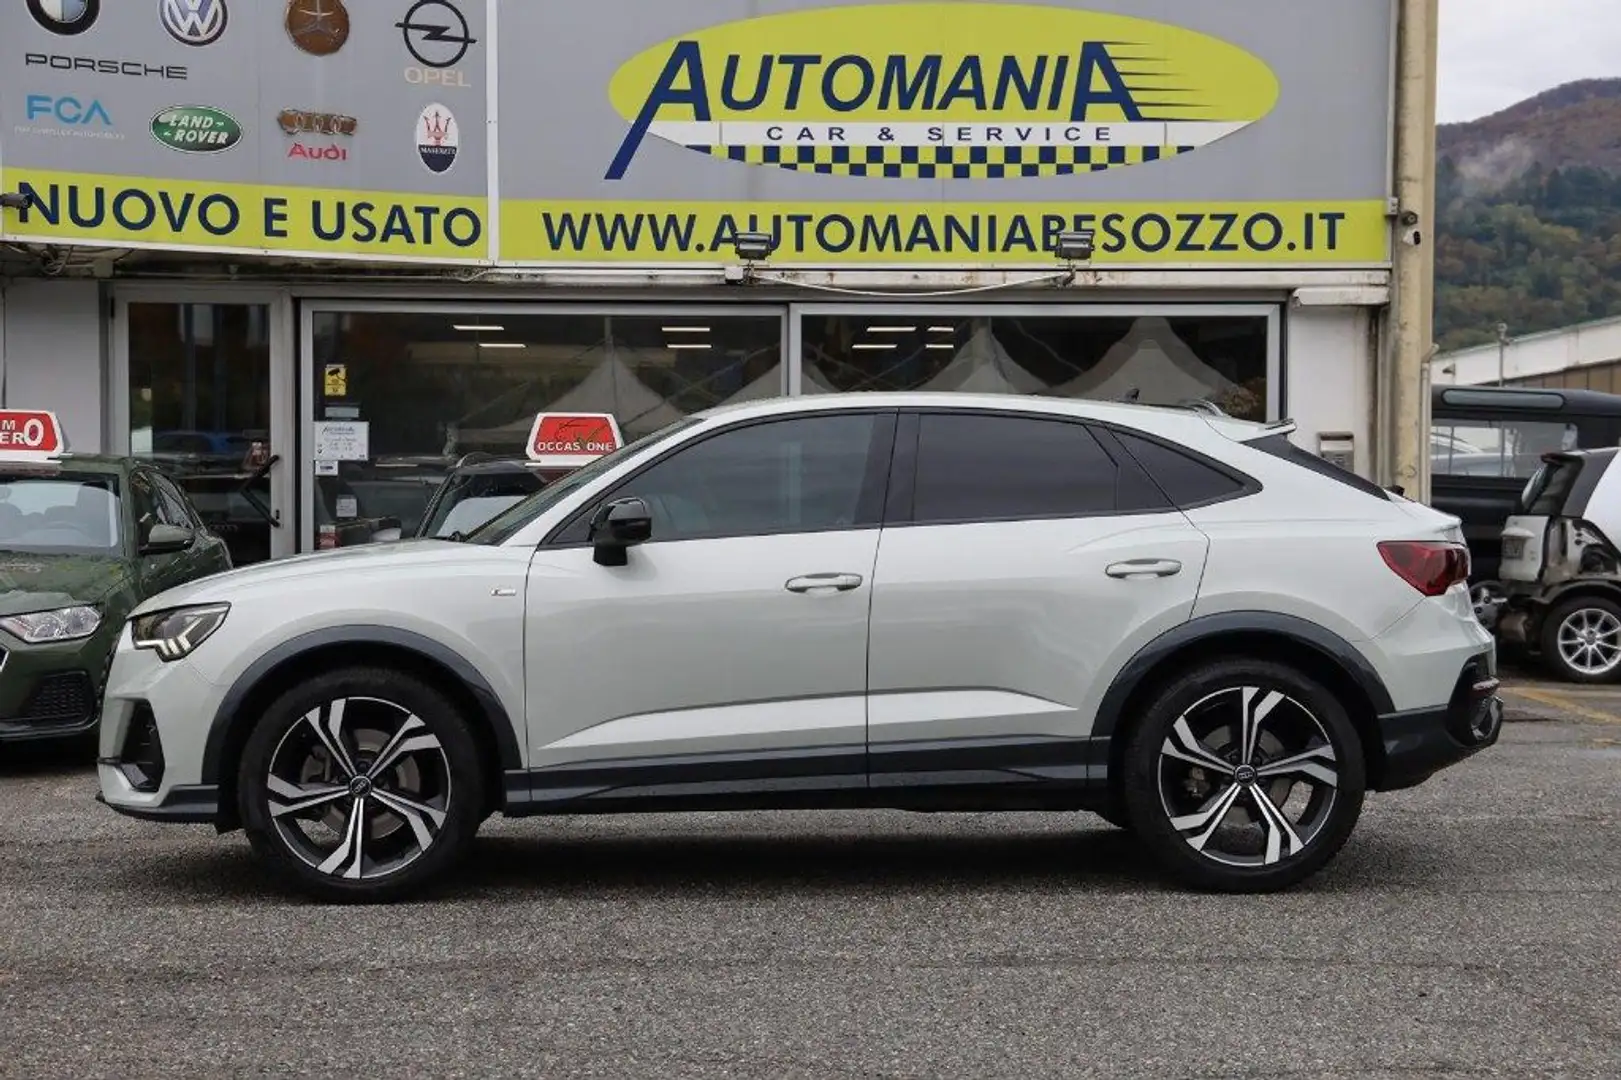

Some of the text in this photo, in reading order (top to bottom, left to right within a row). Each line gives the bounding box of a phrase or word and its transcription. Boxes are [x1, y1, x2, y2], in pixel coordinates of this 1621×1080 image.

[25, 53, 188, 80] PORSCHE
[404, 67, 472, 88] OPEL
[26, 95, 113, 125] FCA
[603, 40, 1143, 180] AUTOMANIA
[169, 115, 214, 129] LAND
[174, 129, 229, 145] ROVER
[766, 126, 1111, 141] CAR & SERVICE
[288, 142, 347, 161] Audi
[18, 182, 482, 247] NUOVO E USATO
[537, 441, 614, 452] OCCASONE
